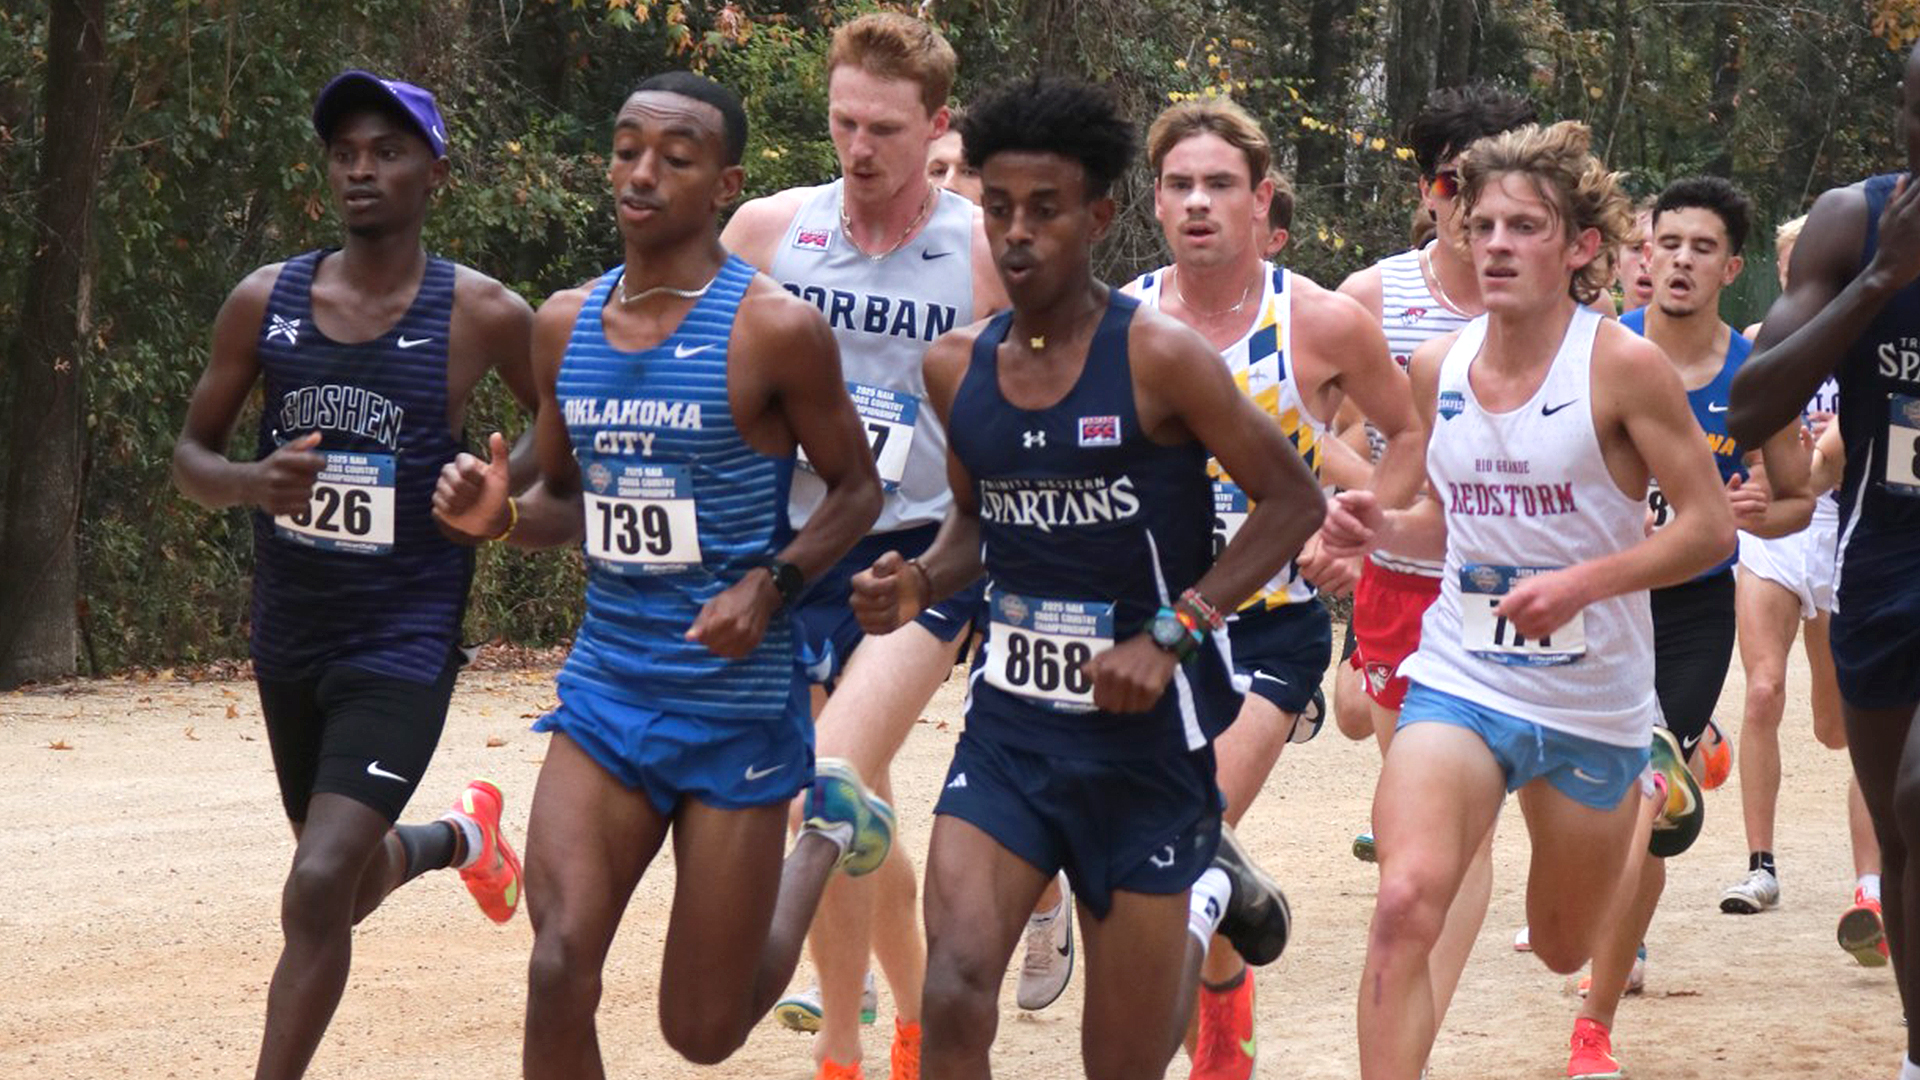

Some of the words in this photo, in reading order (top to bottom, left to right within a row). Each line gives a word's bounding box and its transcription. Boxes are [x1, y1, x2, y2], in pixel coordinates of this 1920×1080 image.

[281, 385, 404, 451] GOSHEN
[565, 398, 702, 430] OKLAHOMA
[594, 431, 655, 456] CITY
[317, 472, 378, 485] CHAMPIONSHIPS
[345, 465, 379, 475] COUNTRY
[1475, 459, 1492, 472] RIO
[1496, 460, 1530, 474] GRANDE
[1035, 476, 1106, 490] WESTERN
[1448, 481, 1578, 517] REDSTORM
[980, 475, 1140, 533] SPARTANS
[596, 501, 672, 556] 739
[1006, 632, 1094, 695] 868
